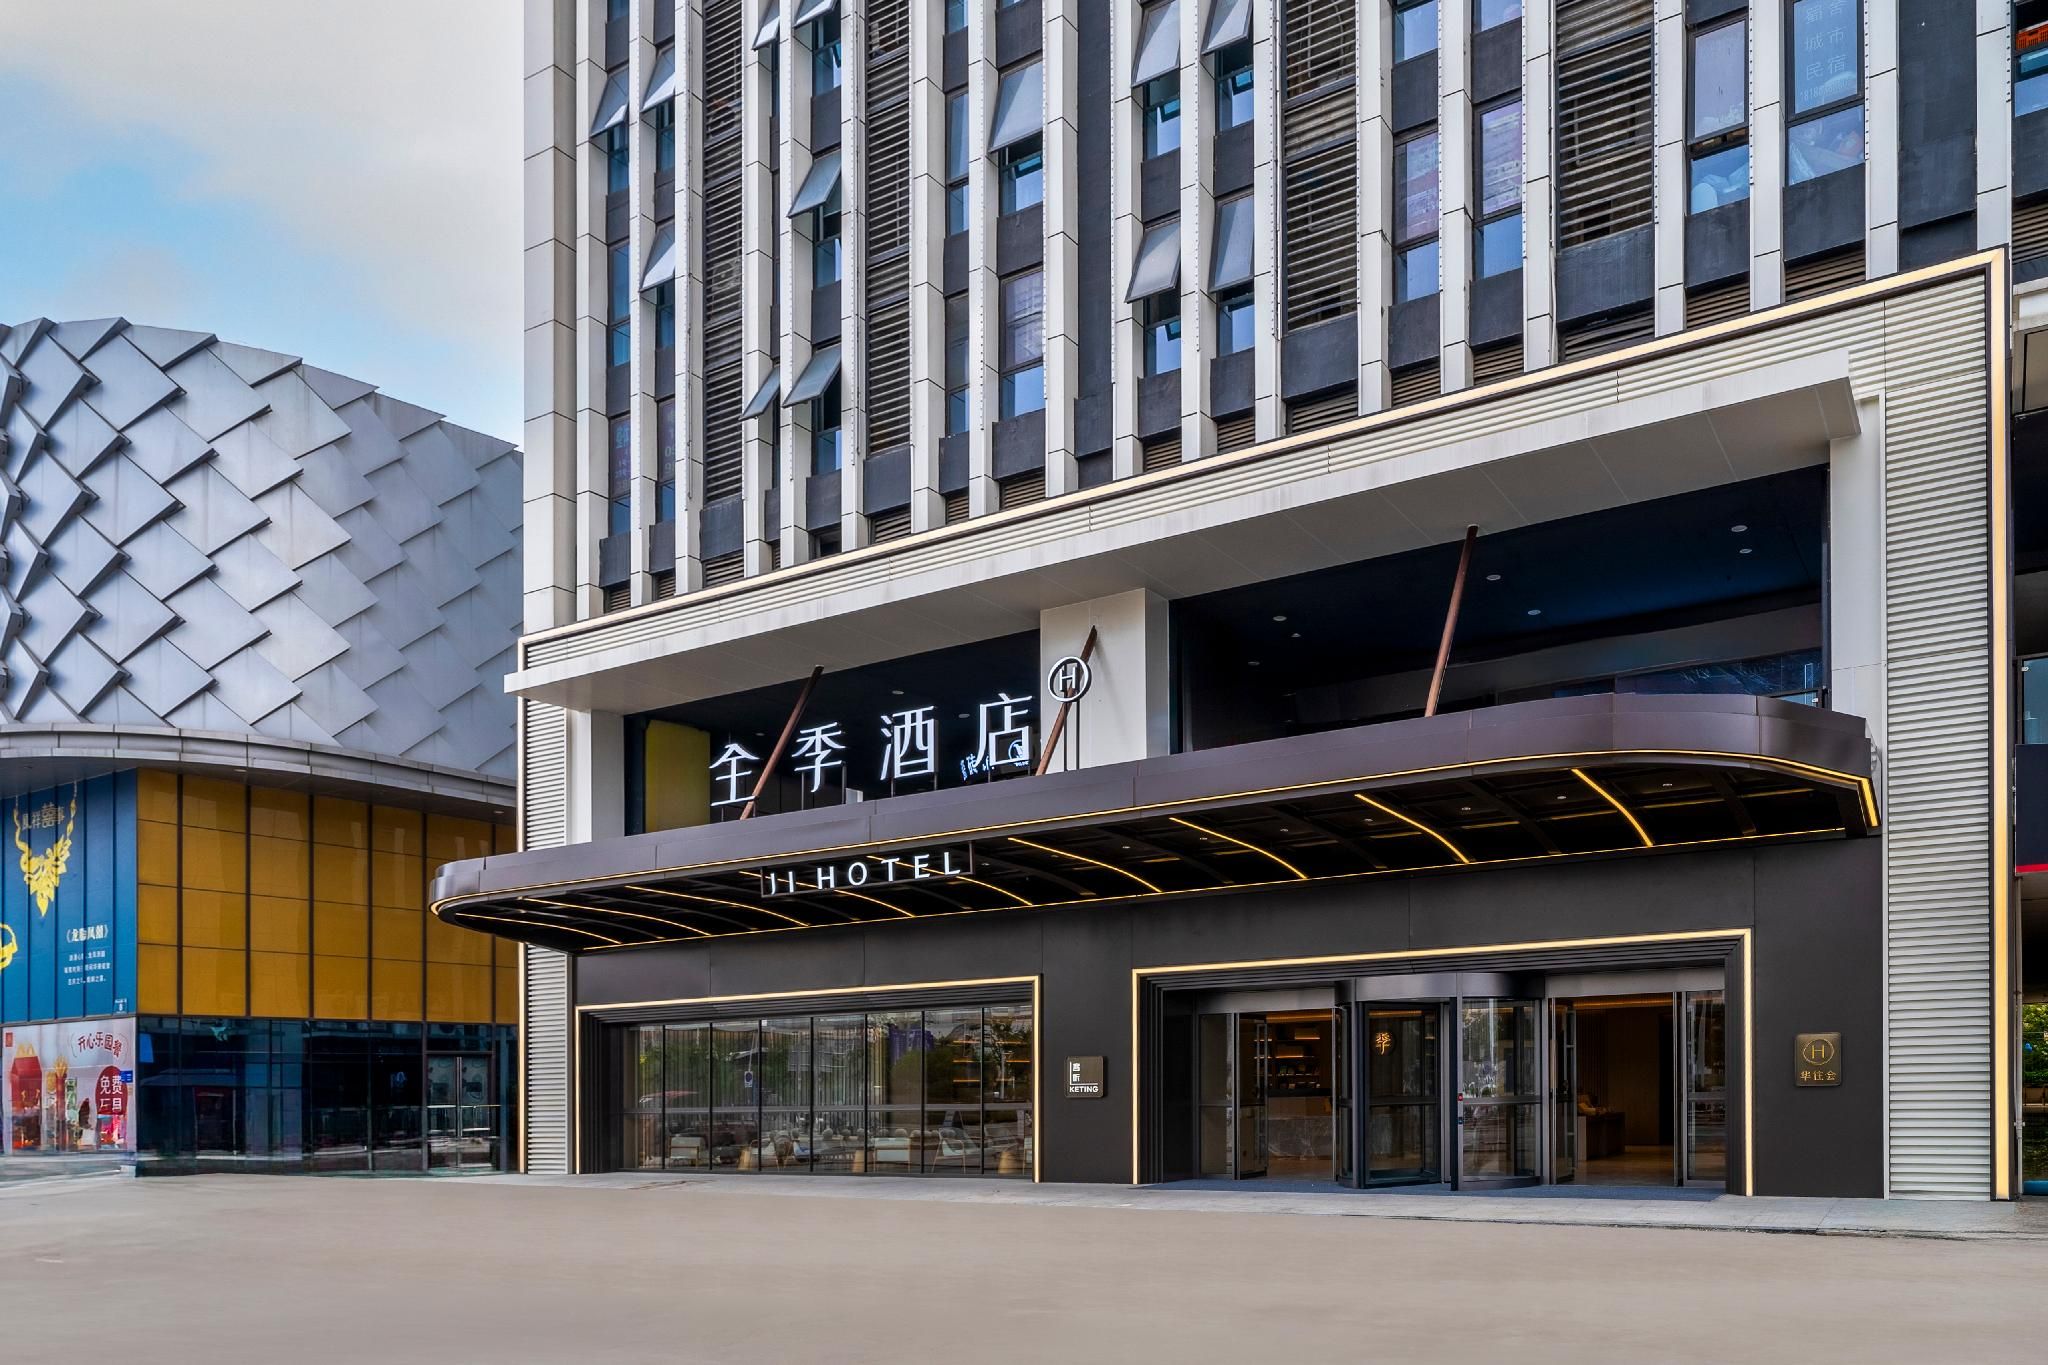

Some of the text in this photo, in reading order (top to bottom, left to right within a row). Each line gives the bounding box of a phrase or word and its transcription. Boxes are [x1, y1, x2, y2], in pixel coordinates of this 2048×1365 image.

[1804, 25, 1848, 52] 城市
[1805, 54, 1848, 80] 民宿
[709, 693, 1033, 807] 全季酒店
[769, 851, 962, 896] JI HOTEL
[78, 1031, 122, 1058] 开心乐园餐
[1375, 1032, 1391, 1055] 季
[100, 1075, 123, 1095] 免费
[1800, 1070, 1837, 1081] 华住会
[1069, 1085, 1099, 1093] KETING
